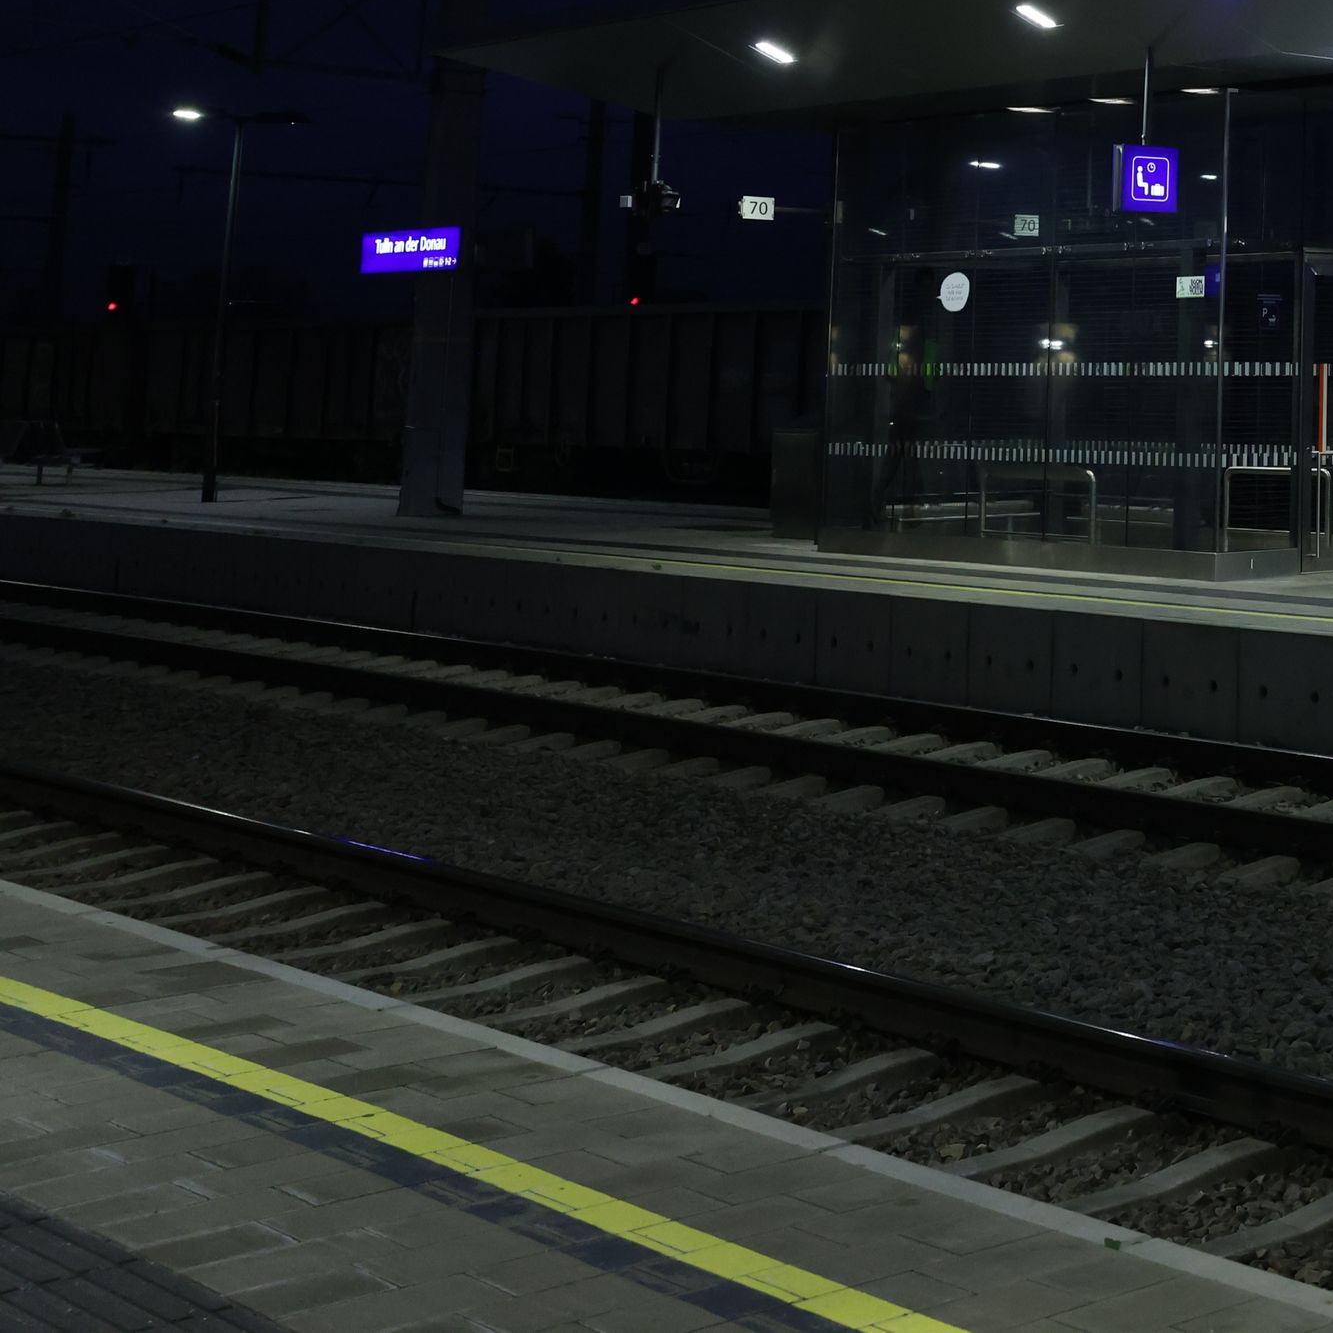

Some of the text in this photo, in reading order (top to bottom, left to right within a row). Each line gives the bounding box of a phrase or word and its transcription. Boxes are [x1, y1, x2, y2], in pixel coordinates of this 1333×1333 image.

[750, 201, 768, 215] 70
[1021, 219, 1035, 232] 70
[375, 235, 447, 254] Tulln an der Donau
